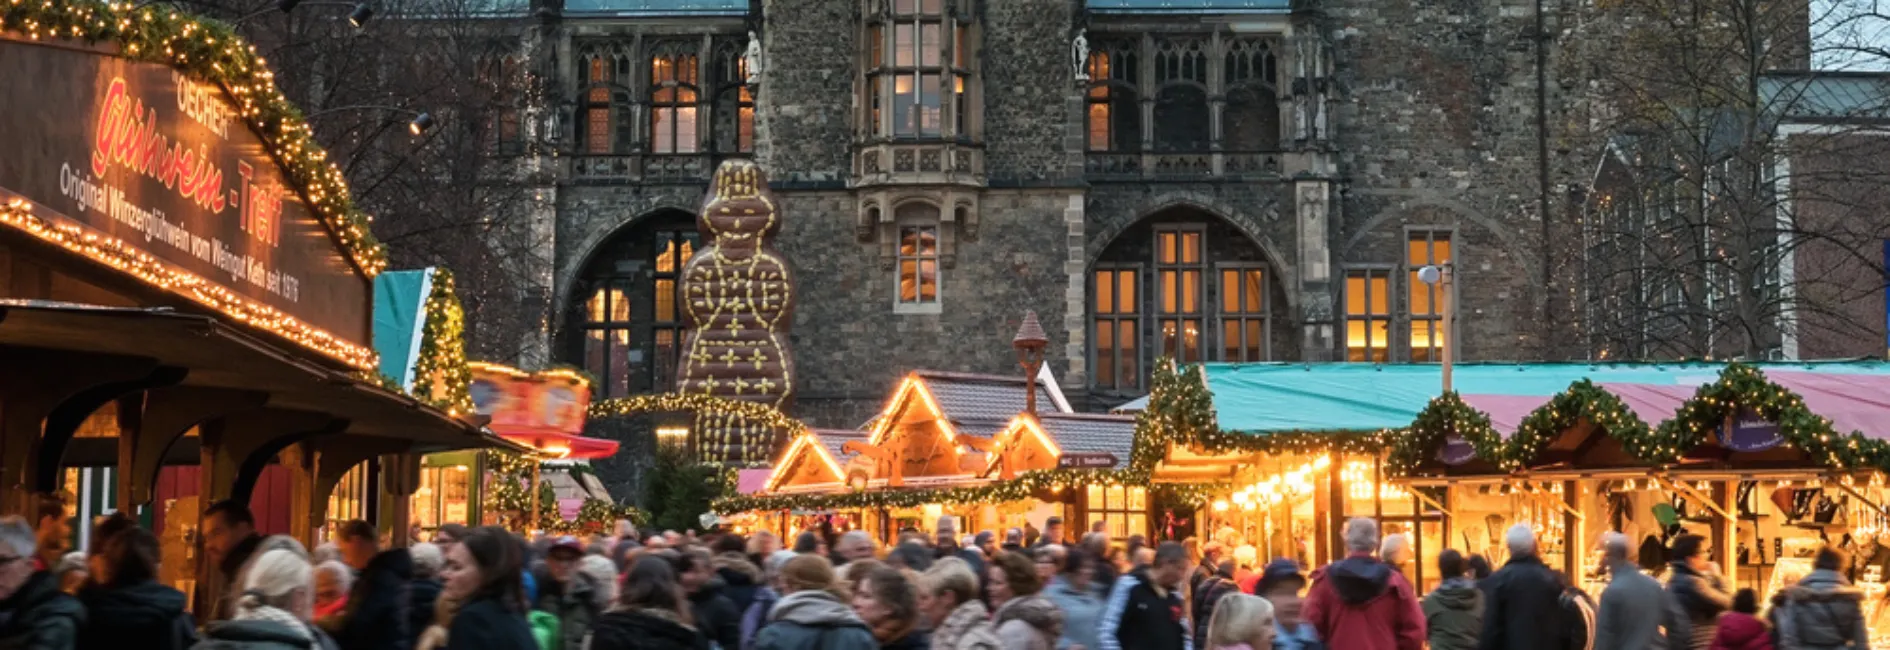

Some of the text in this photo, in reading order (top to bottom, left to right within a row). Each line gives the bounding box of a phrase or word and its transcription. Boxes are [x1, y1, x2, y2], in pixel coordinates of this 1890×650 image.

[92, 77, 225, 214] Glühwein
[60, 162, 108, 213] Original
[109, 184, 190, 252] Winzerglühwein
[191, 234, 211, 263] vom
[211, 236, 247, 282] Weingut
[266, 268, 281, 296] seit
